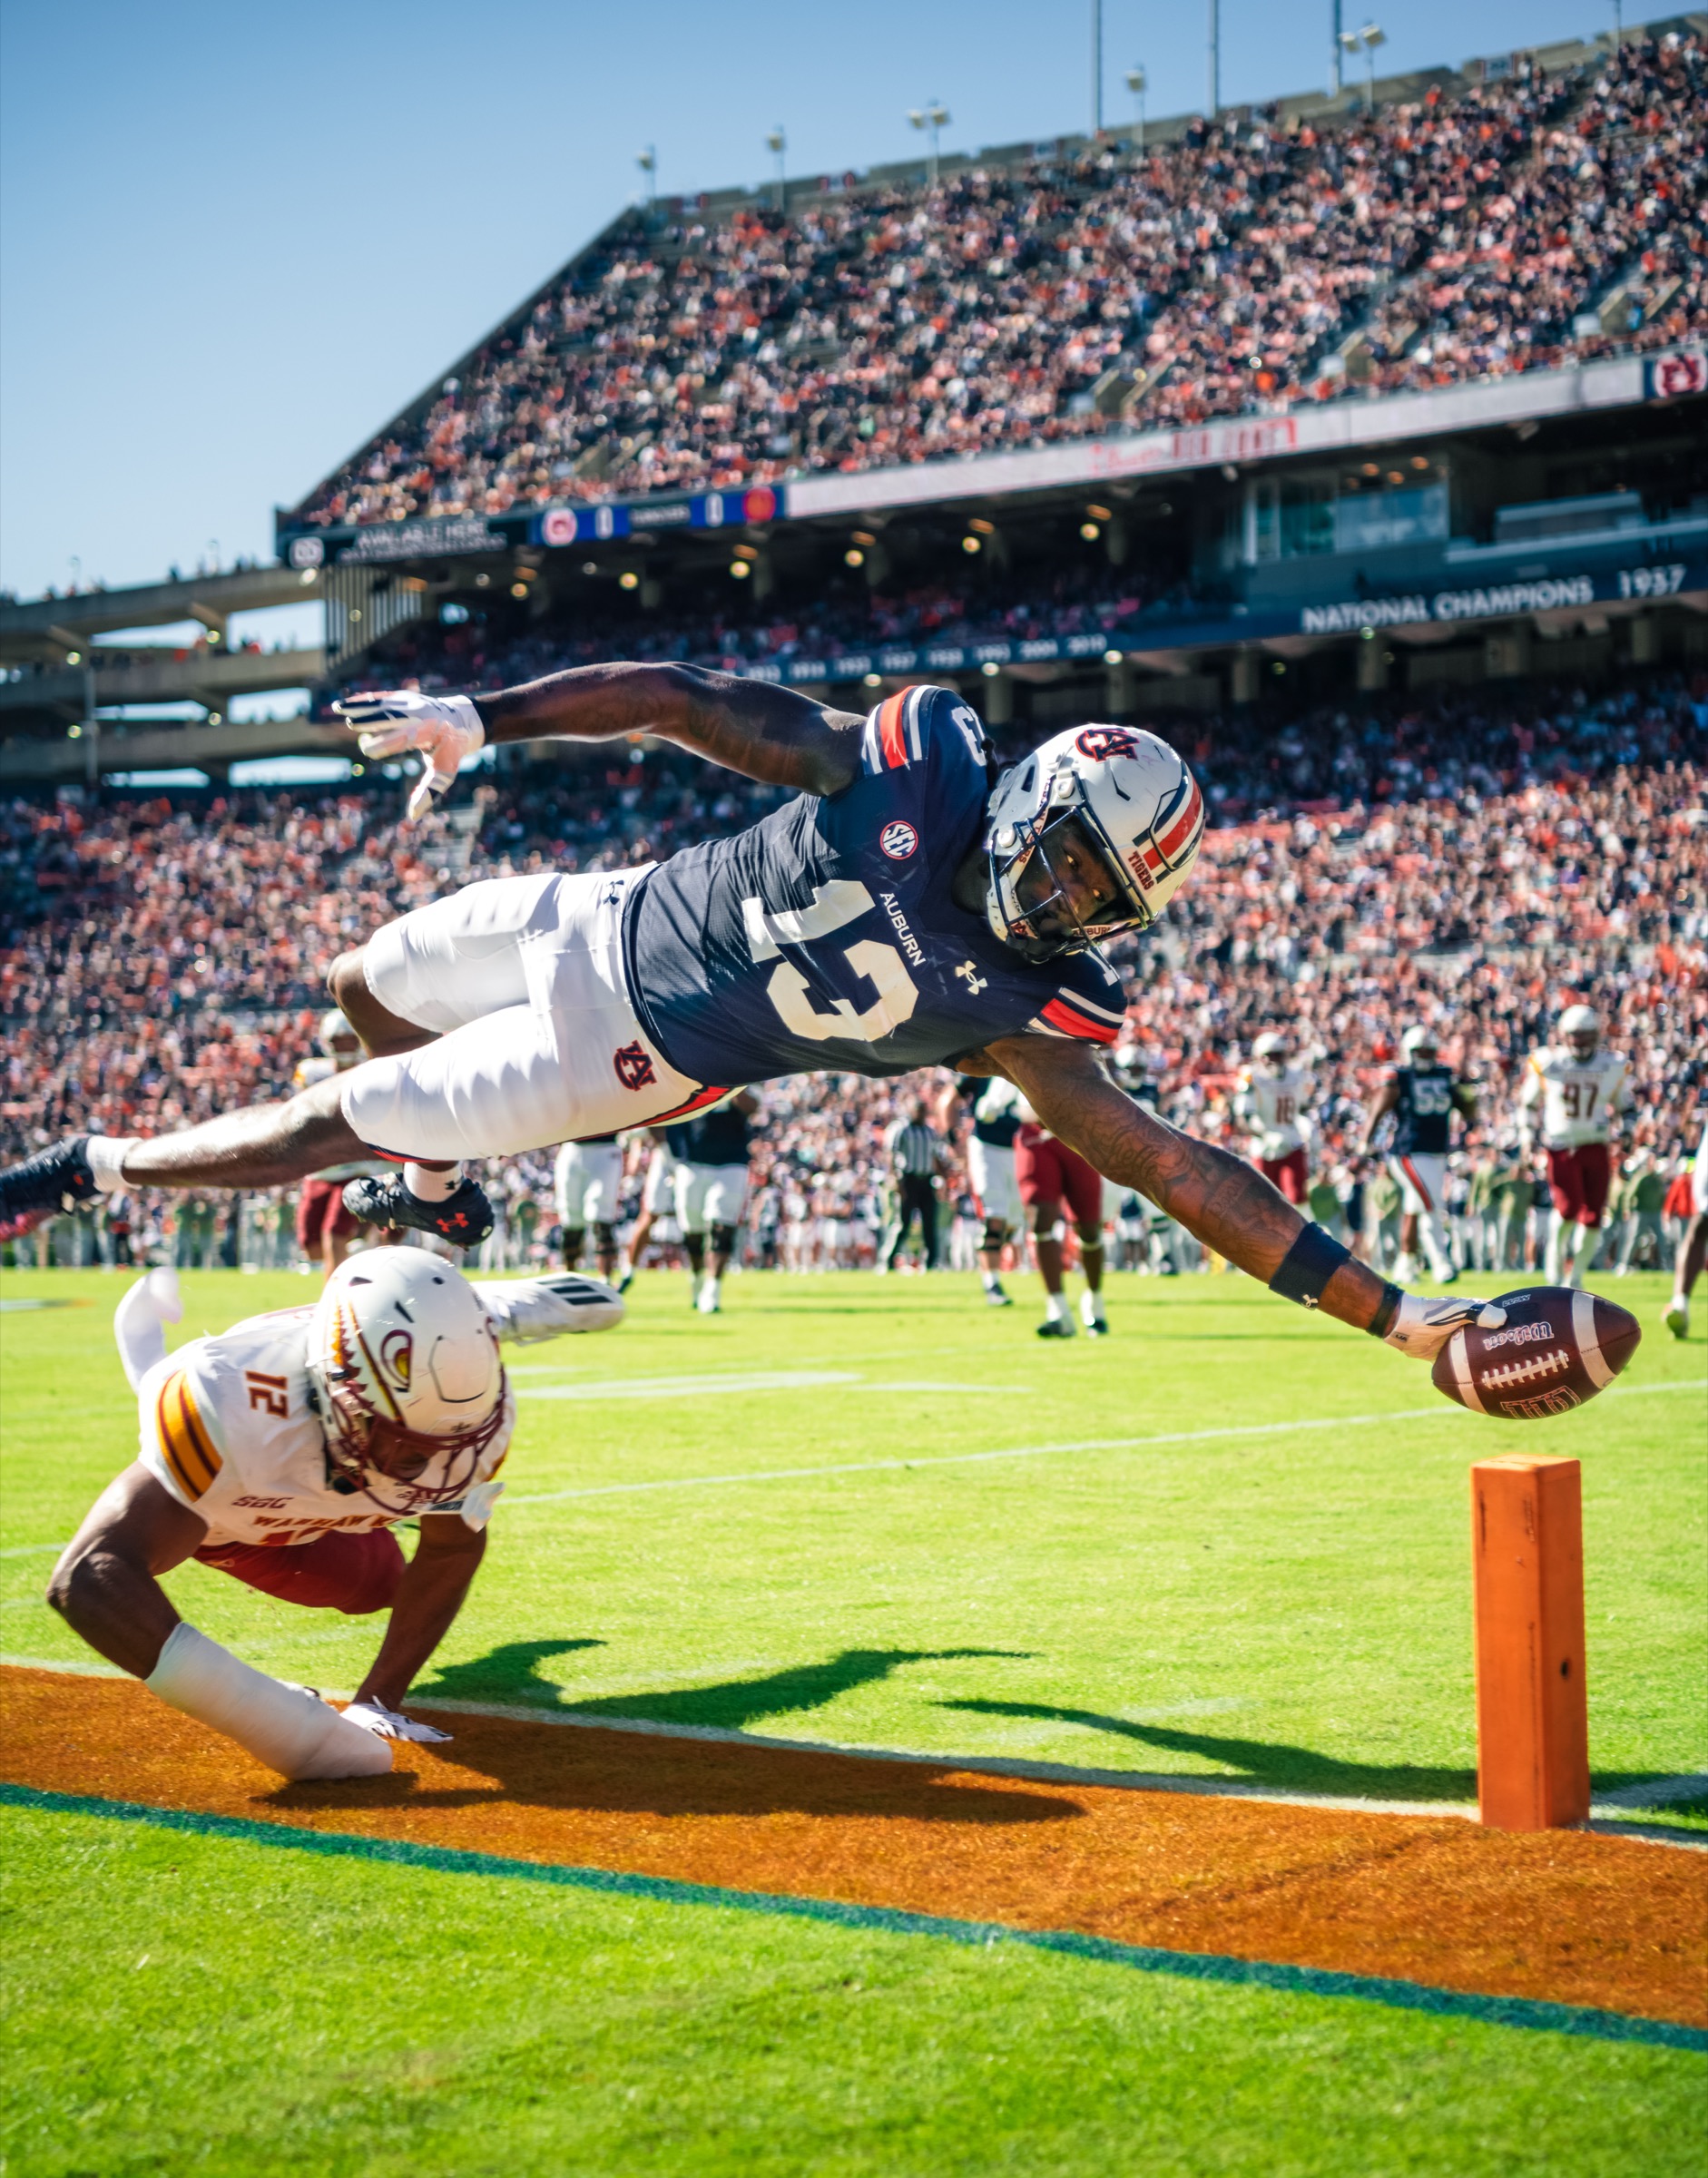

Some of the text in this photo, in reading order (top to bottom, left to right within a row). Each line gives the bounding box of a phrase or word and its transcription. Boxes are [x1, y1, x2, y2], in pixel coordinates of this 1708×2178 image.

[1301, 563, 1687, 633] NATIONAL CHAMPIONS 1957
[882, 823, 917, 858] SEC
[1128, 850, 1155, 891] TIGERS
[879, 892, 927, 967] AUBURN
[741, 879, 919, 1043] 13
[1412, 1076, 1452, 1115] 55
[1563, 1081, 1600, 1121] 97
[1483, 1321, 1555, 1350] Wilson
[246, 1370, 290, 1419] 12
